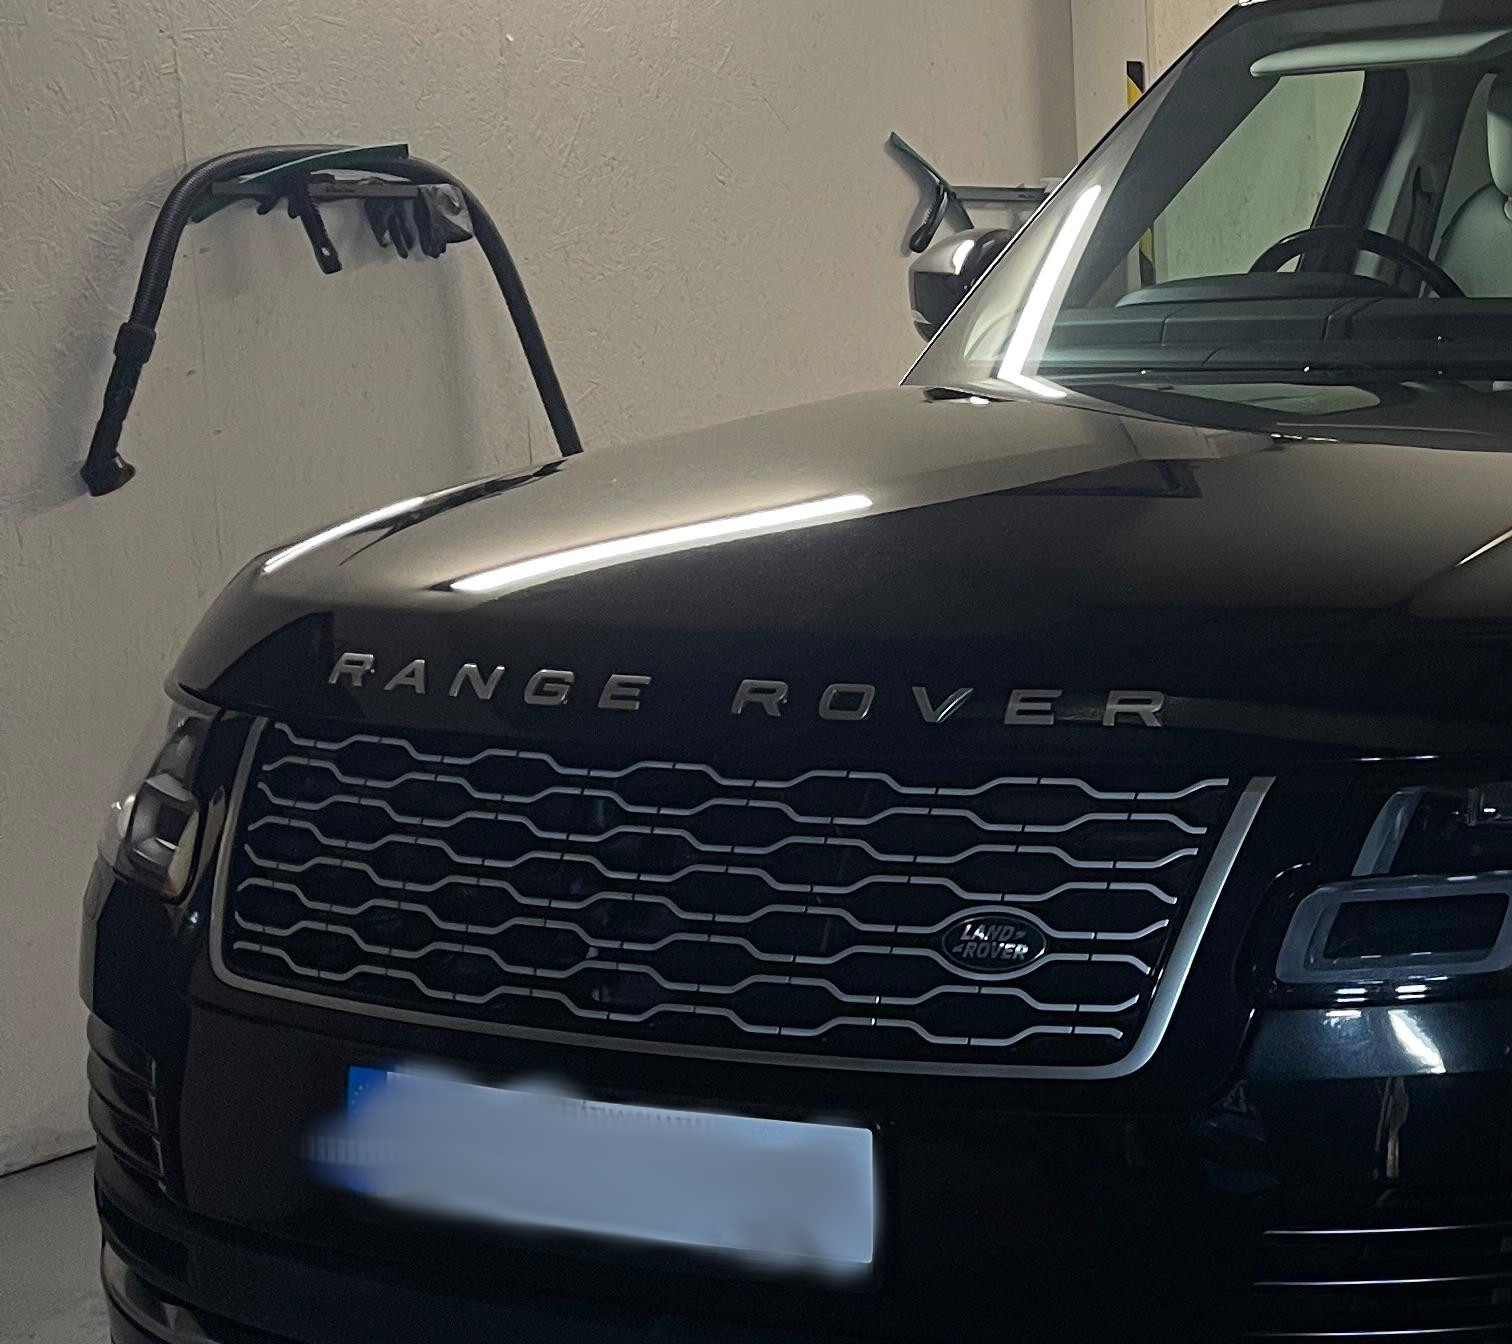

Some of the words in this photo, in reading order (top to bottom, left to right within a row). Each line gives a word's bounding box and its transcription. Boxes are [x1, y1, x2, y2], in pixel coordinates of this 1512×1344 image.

[328, 652, 652, 711] RANGE
[731, 678, 1168, 728] ROVER
[960, 924, 1016, 941] LAND
[962, 941, 1029, 960] ROVER
